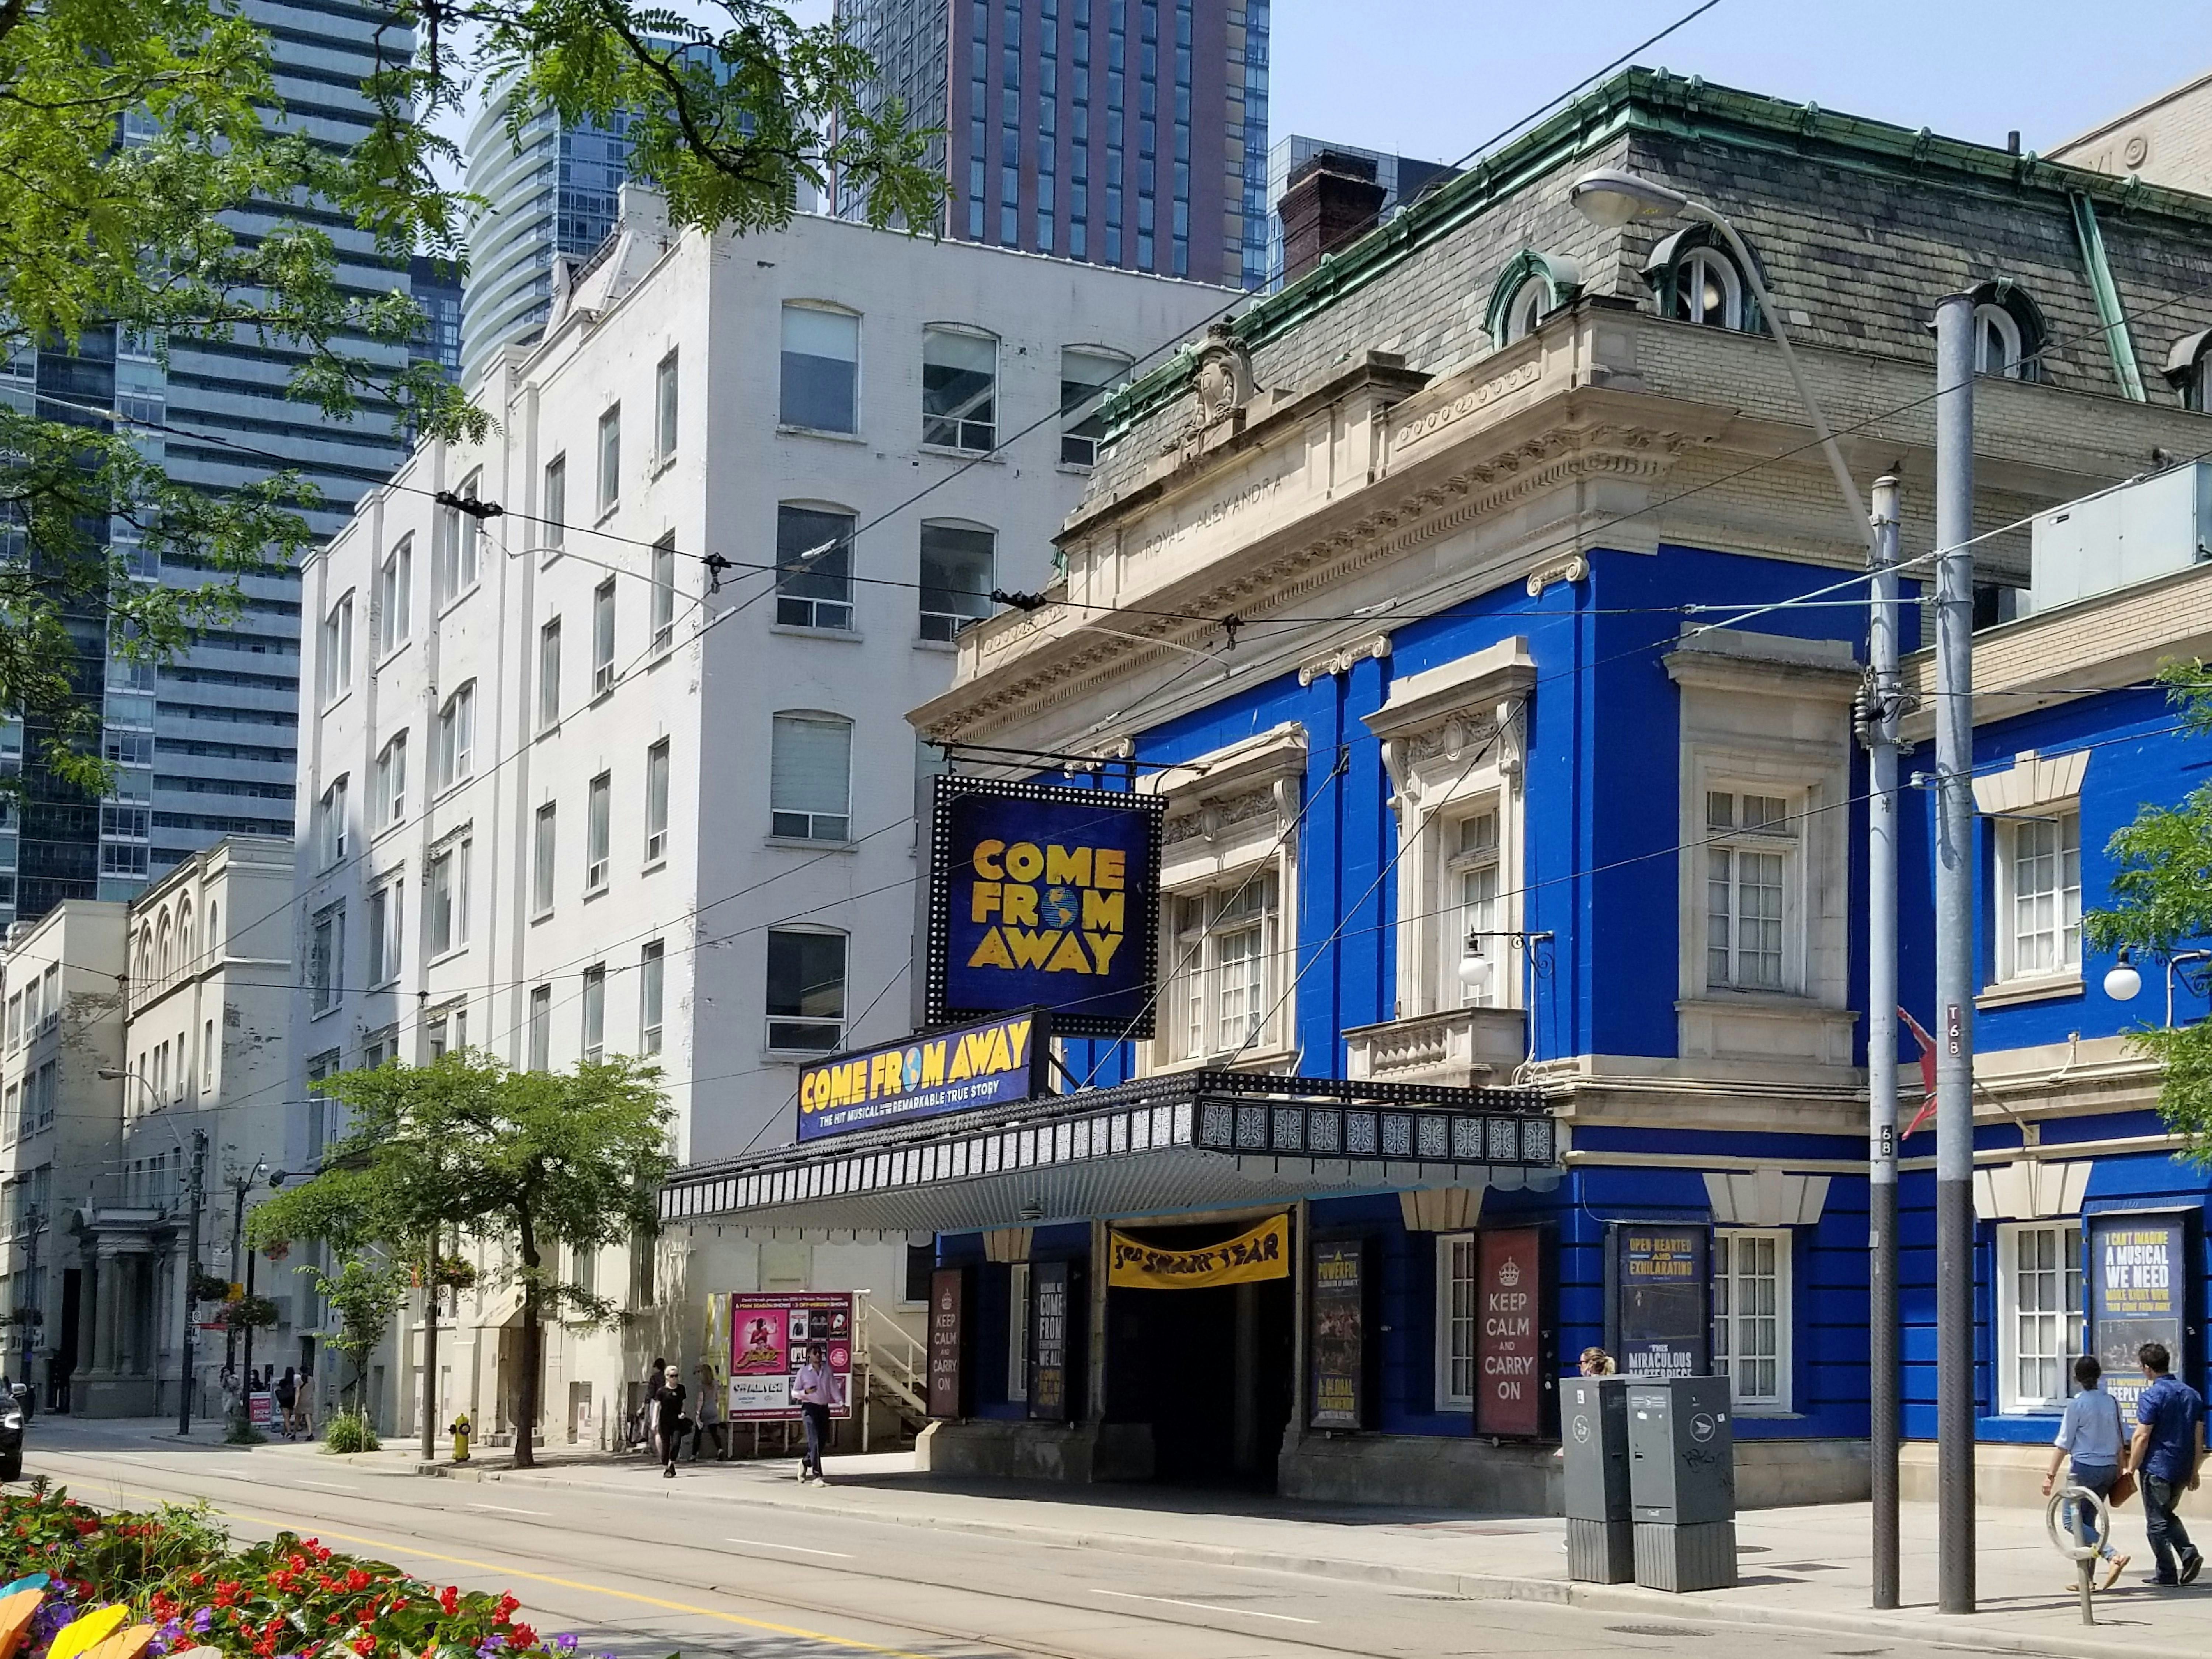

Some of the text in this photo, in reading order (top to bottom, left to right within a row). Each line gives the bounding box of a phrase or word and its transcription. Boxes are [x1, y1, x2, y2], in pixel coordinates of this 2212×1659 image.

[1146, 473, 1282, 561] ROYAL ALEXANDRA
[973, 839, 1126, 890] COME
[972, 880, 1125, 932] FROM
[966, 925, 1124, 975] AWAY
[801, 1020, 1032, 1113] COME FROM AWAY
[892, 1080, 1000, 1113] REMARKABLE TRUE STORY
[820, 1106, 879, 1127] THE HIT MUSICAL
[1219, 1233, 1279, 1268] YEAR
[2106, 1245, 2168, 1265] A MUSICAL
[2106, 1265, 2168, 1288] WE NEED
[1040, 1294, 1063, 1315] COME
[1489, 1293, 1527, 1311] KEEP
[936, 1314, 956, 1327] KEEP
[1039, 1317, 1062, 1339] FROM
[1486, 1318, 1529, 1336] CALM
[934, 1332, 957, 1345] CALM
[1499, 1342, 1515, 1350] AND
[933, 1360, 957, 1372] CARRY
[1039, 1350, 1061, 1366] WE ALL
[1485, 1356, 1533, 1374] CARRY
[1629, 1352, 1692, 1368] MIRACULOUS
[938, 1377, 950, 1390] ON
[1498, 1381, 1520, 1399] ON
